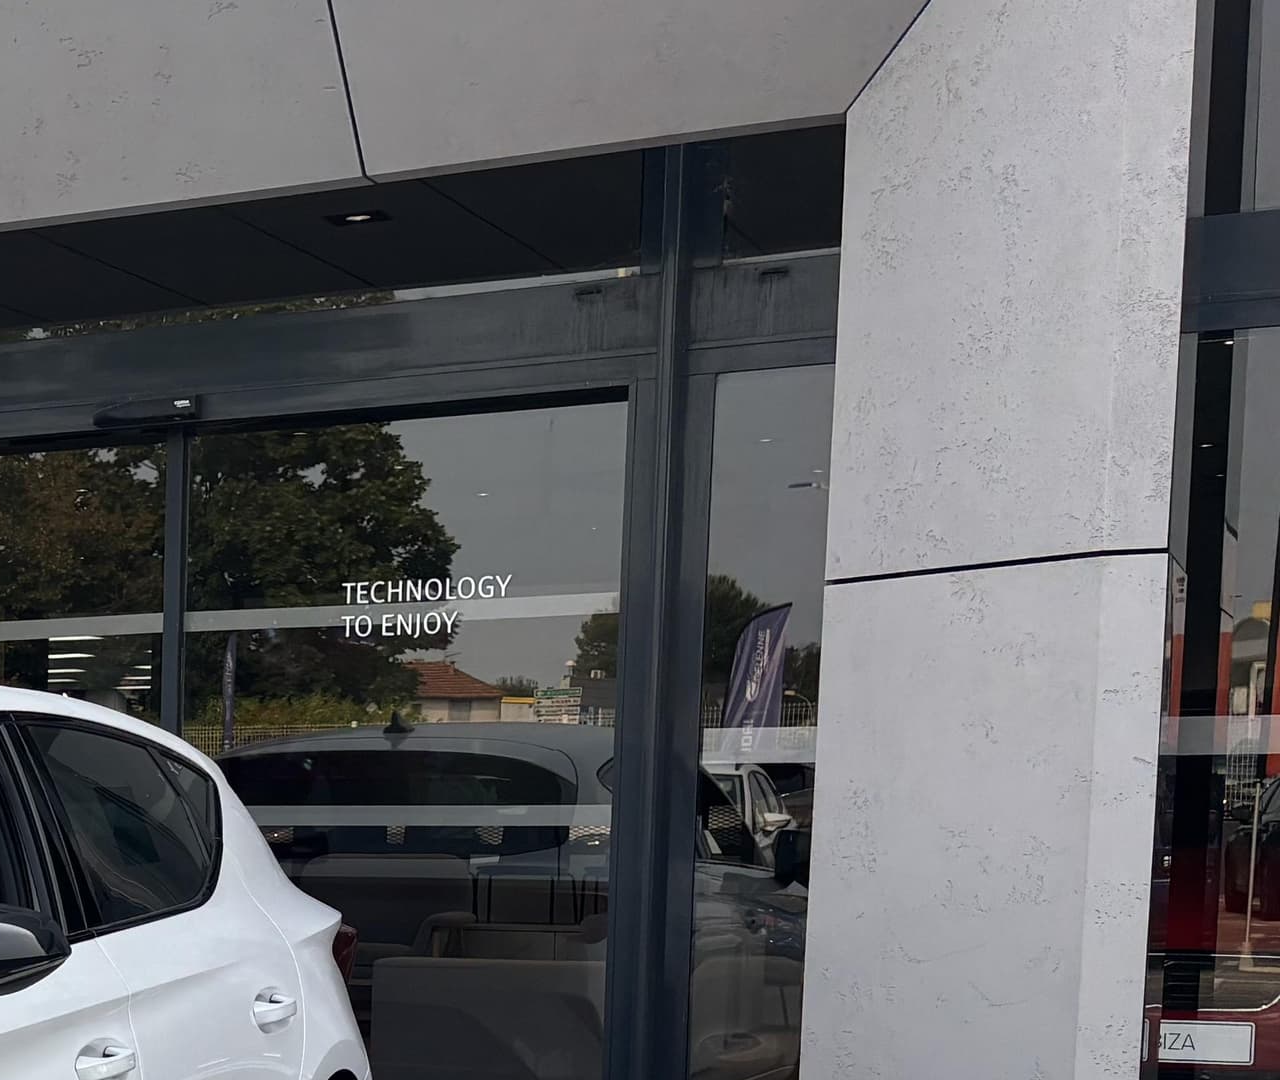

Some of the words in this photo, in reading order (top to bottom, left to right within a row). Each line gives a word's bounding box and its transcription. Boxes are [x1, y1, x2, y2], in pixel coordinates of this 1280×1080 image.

[342, 574, 513, 605] TECHNOLOGY
[341, 615, 372, 638] TO
[381, 611, 458, 638] ENJOY
